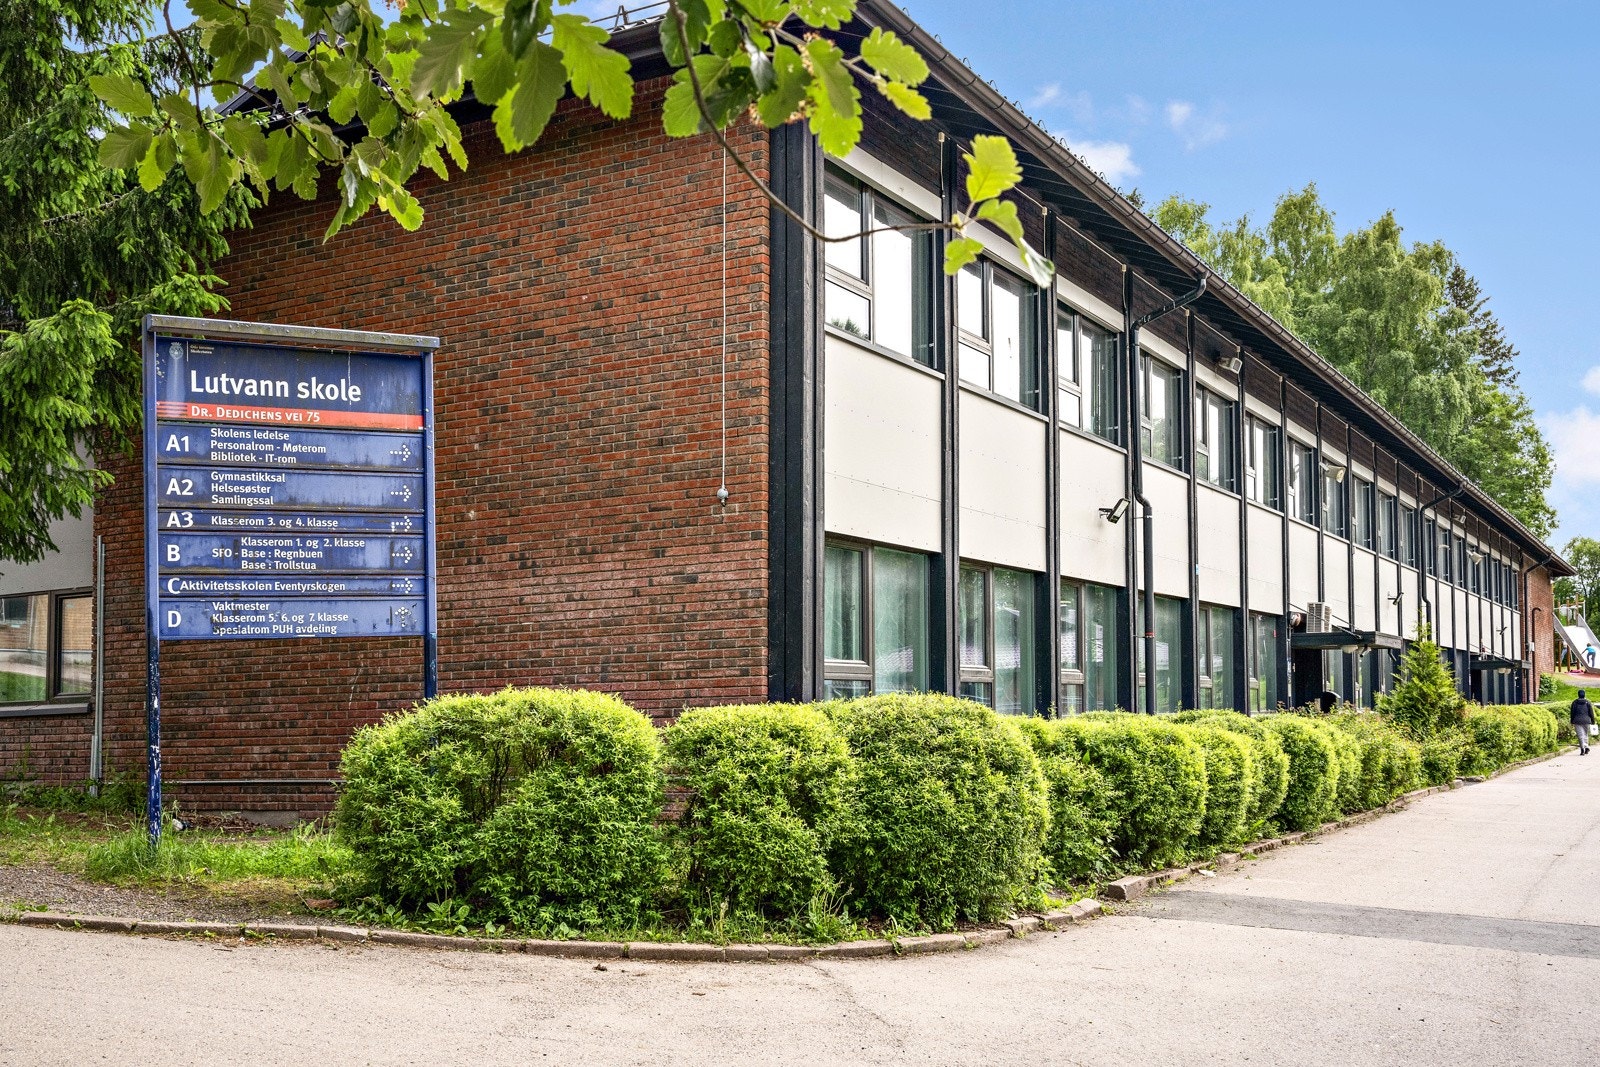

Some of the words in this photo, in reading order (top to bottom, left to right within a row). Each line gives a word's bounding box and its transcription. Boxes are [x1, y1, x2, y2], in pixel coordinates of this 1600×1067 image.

[191, 370, 289, 397] Lutvann
[297, 377, 362, 402] skole
[307, 412, 320, 422] 75
[211, 428, 251, 440] Skolens
[254, 430, 289, 440] ledelse
[166, 435, 190, 452] A1
[211, 440, 274, 451] Personalrom
[283, 443, 326, 453] Møterom
[211, 452, 256, 462] Bibliotek
[265, 455, 297, 464] IT-rom
[211, 471, 285, 483] Gymnastikksal
[166, 479, 193, 496] A2
[211, 483, 271, 494] Helsesøster
[211, 495, 274, 506] Samlingssal
[167, 512, 193, 528] A3
[211, 516, 264, 526] Klasserom
[268, 517, 276, 527] 3.
[280, 519, 292, 529] og
[296, 518, 304, 527] 4.
[307, 518, 338, 527] klasse
[241, 537, 292, 547] Klasserom
[296, 538, 303, 547] 1.
[306, 540, 318, 549] og
[323, 538, 333, 547] 2.
[335, 538, 365, 547] klasse
[167, 545, 181, 562] B
[212, 548, 232, 558] SFO
[242, 549, 266, 558] Base
[274, 549, 323, 560] Regnbuen
[242, 560, 266, 570] Base
[274, 560, 316, 570] Trollstua
[167, 578, 181, 594] C
[180, 581, 272, 591] Aktivitetsskolen
[275, 581, 345, 593] Eventyrskogen
[212, 602, 270, 611] Vaktmester
[168, 610, 181, 627] D
[212, 613, 265, 622] Klasserom
[292, 616, 304, 625] og
[309, 613, 316, 623] 7.
[318, 613, 349, 622] klasse
[213, 625, 270, 636] Spesialrom
[272, 625, 293, 634] PUH
[296, 624, 337, 635] avdeling
